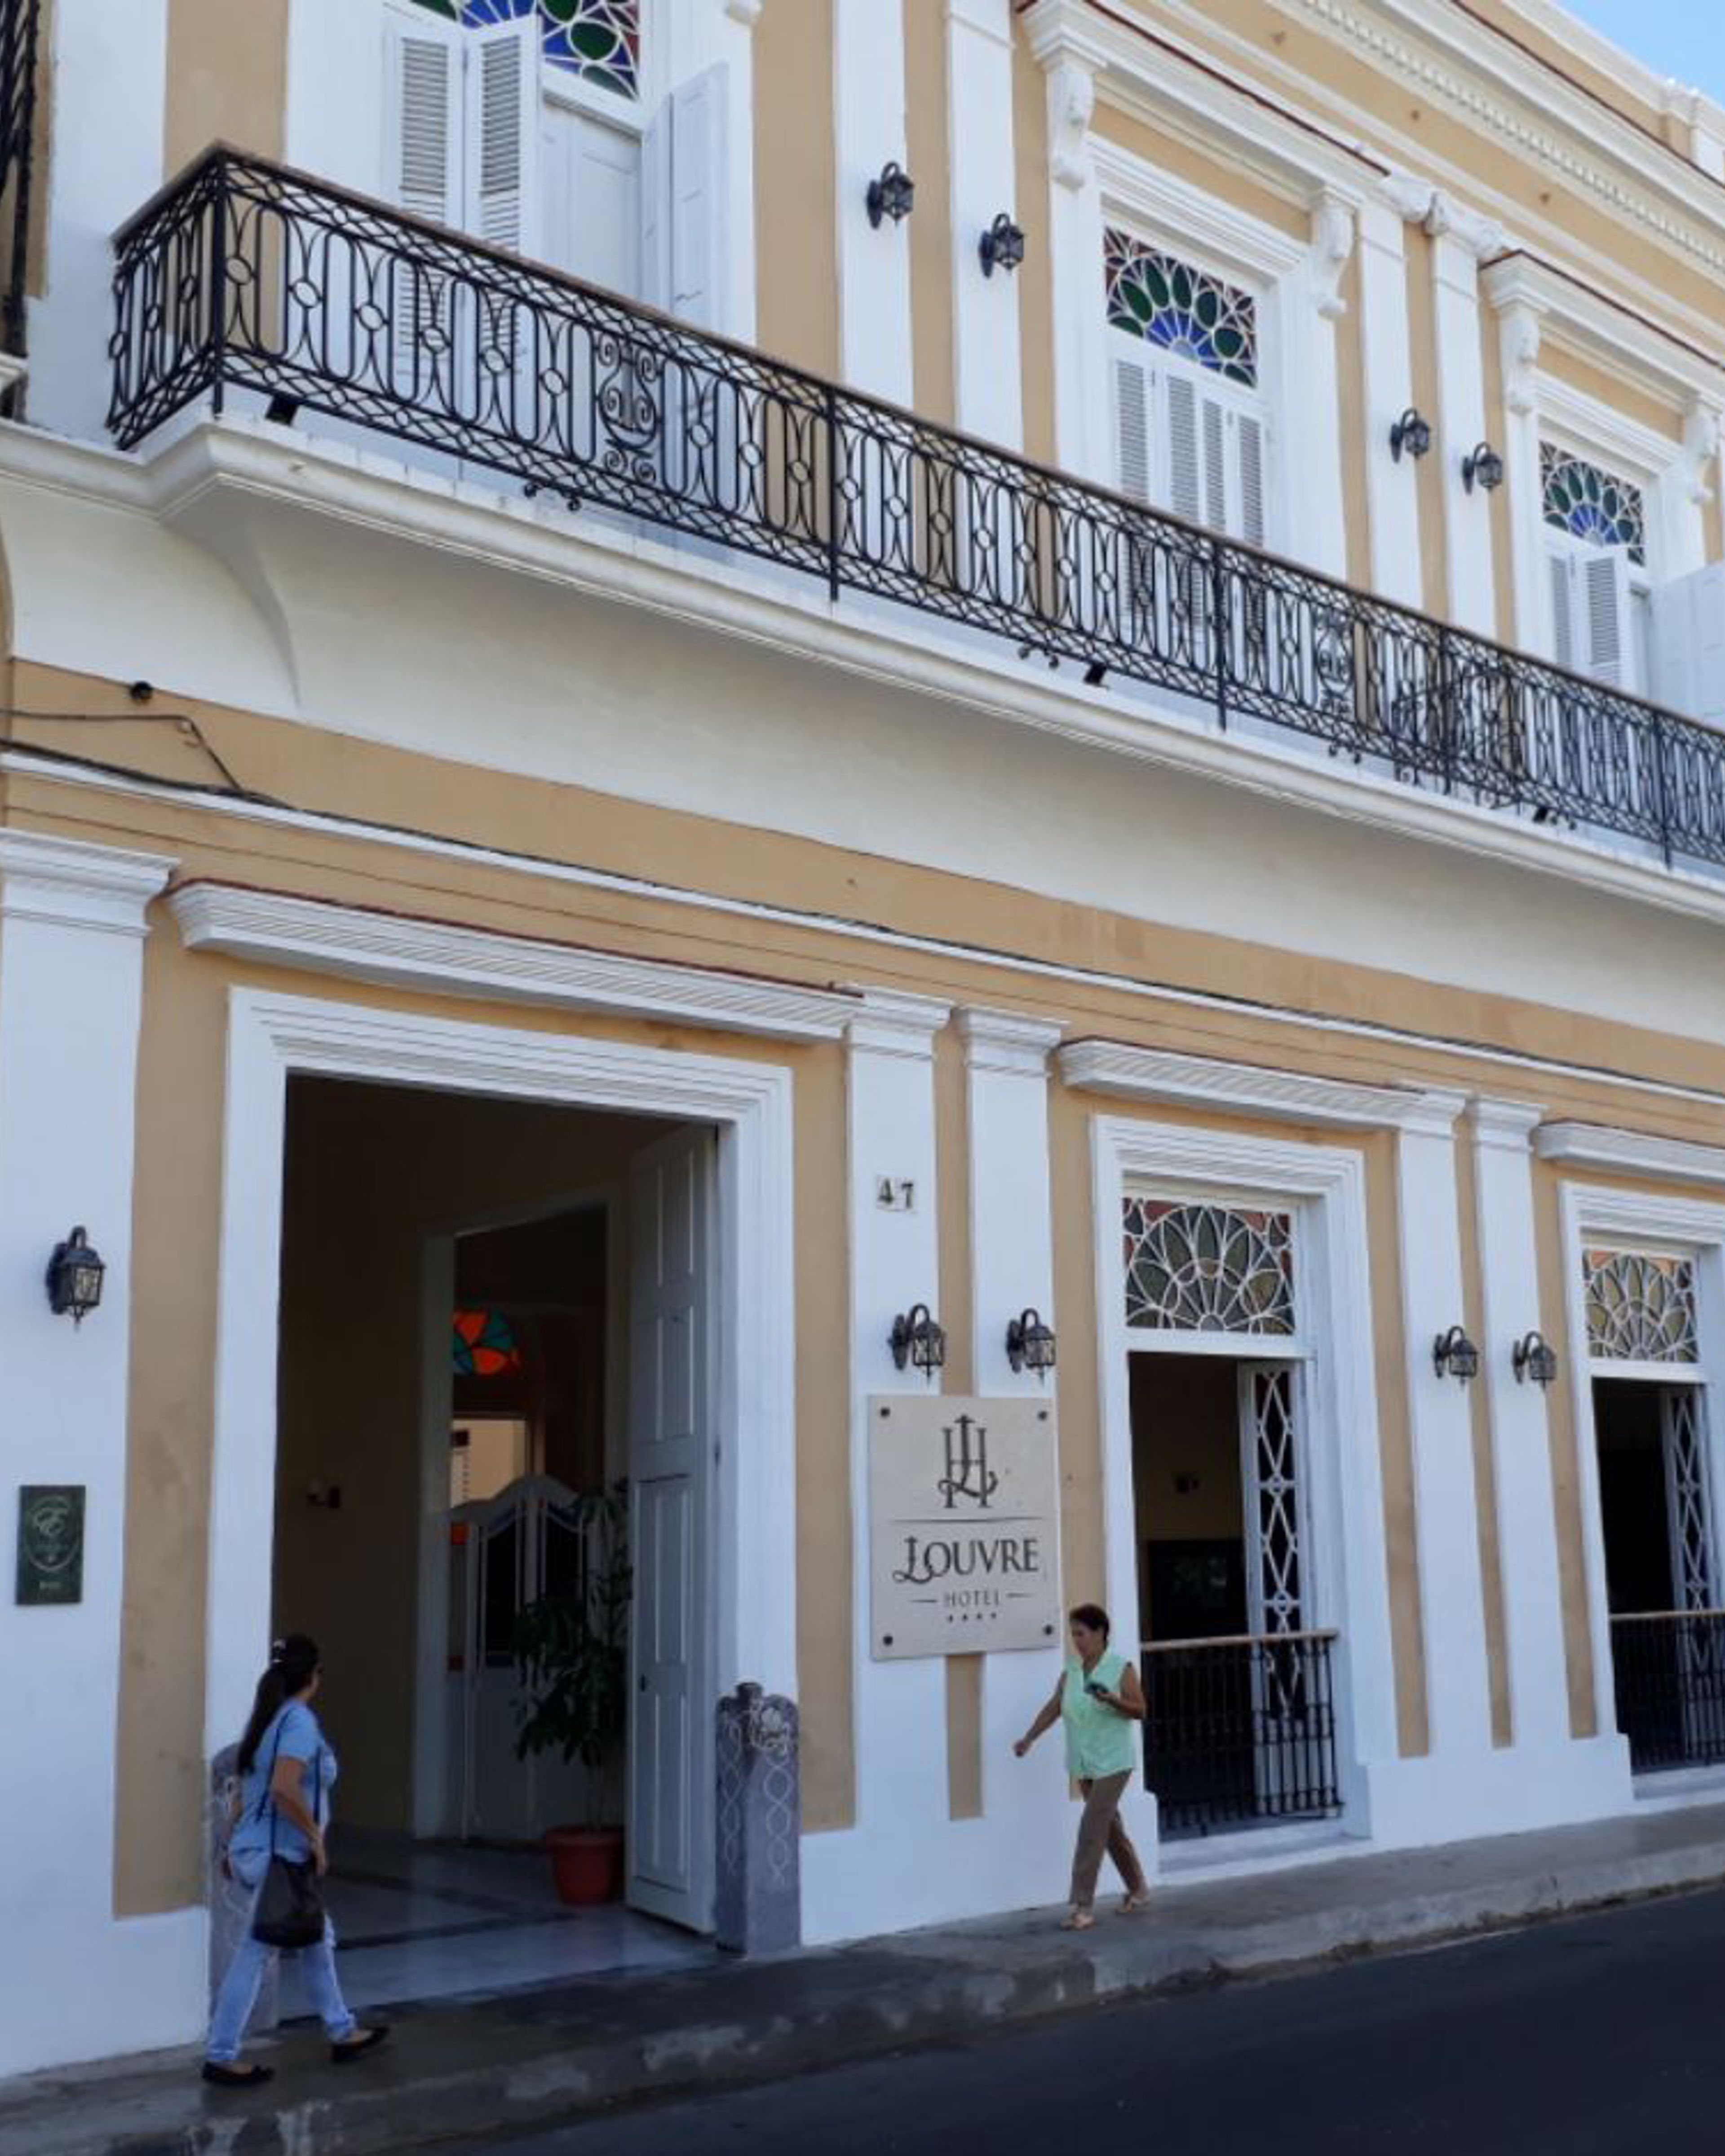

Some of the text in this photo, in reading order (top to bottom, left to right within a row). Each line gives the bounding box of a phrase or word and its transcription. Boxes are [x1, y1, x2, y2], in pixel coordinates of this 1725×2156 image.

[877, 1179, 913, 1209] 47
[893, 1536, 1038, 1584] LOUVRE
[945, 1589, 1000, 1607] HOTEL
